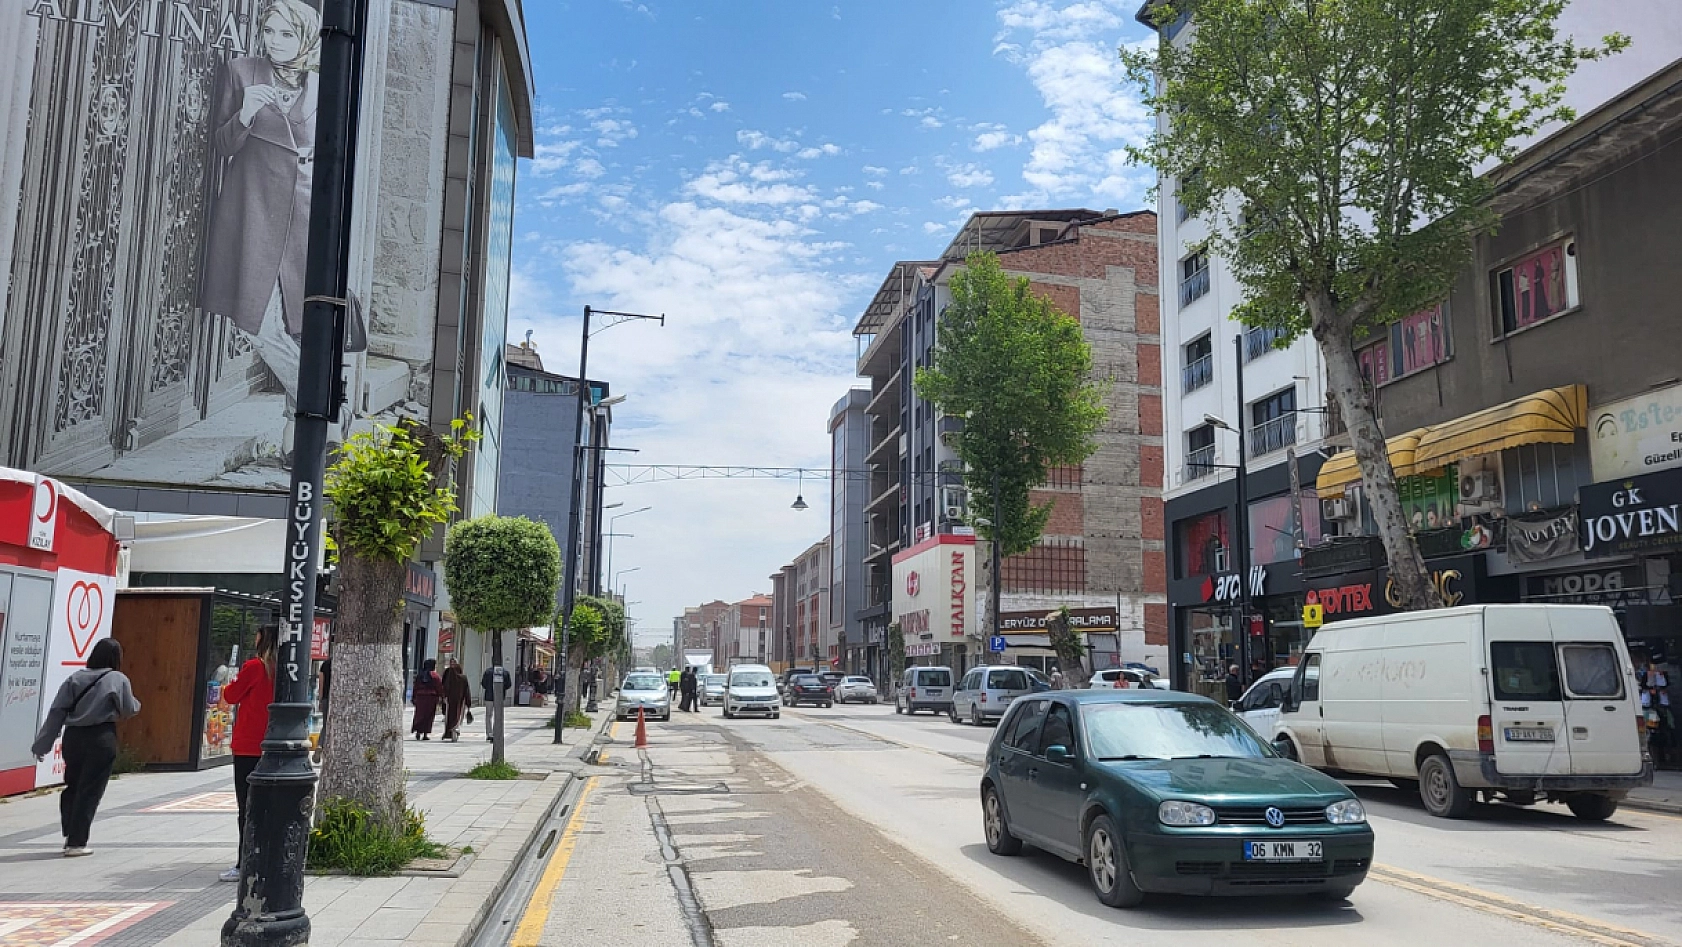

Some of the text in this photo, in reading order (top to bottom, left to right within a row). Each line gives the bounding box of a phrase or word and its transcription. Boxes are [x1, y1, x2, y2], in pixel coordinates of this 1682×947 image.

[1644, 448, 1682, 465] Güzell
[1522, 514, 1576, 548] JOVEN
[1584, 504, 1679, 551] JOVEN
[951, 551, 966, 637] HALKTAN
[1544, 571, 1622, 596] MODA
[1318, 583, 1373, 614] TOYTEX
[999, 617, 1037, 628] LERYÜZ
[1252, 843, 1266, 857] 06
[1307, 843, 1321, 857] 32
